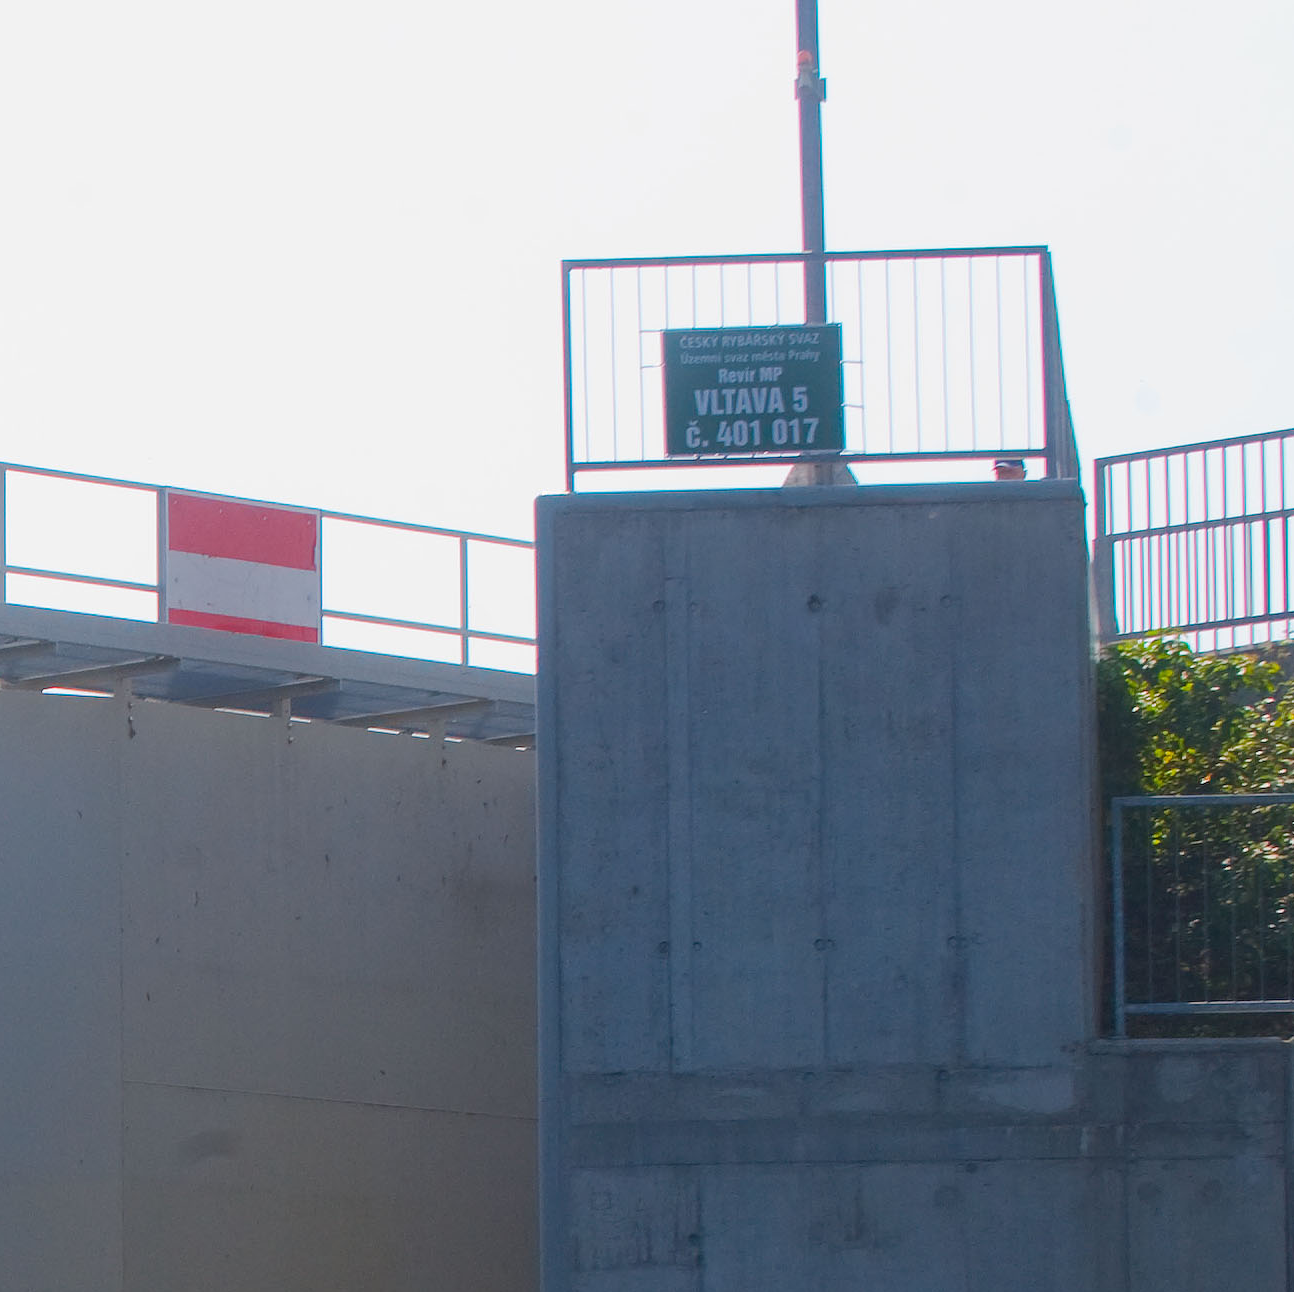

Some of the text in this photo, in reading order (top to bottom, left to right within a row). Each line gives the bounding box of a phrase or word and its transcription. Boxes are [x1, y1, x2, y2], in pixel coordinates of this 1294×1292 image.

[788, 332, 821, 345] SVAZ
[724, 354, 749, 363] svaz
[788, 349, 821, 362] Prahy
[717, 366, 783, 384] Revír MP
[694, 386, 809, 416] VLTAVA 5
[685, 417, 820, 448] Č. 401 017
